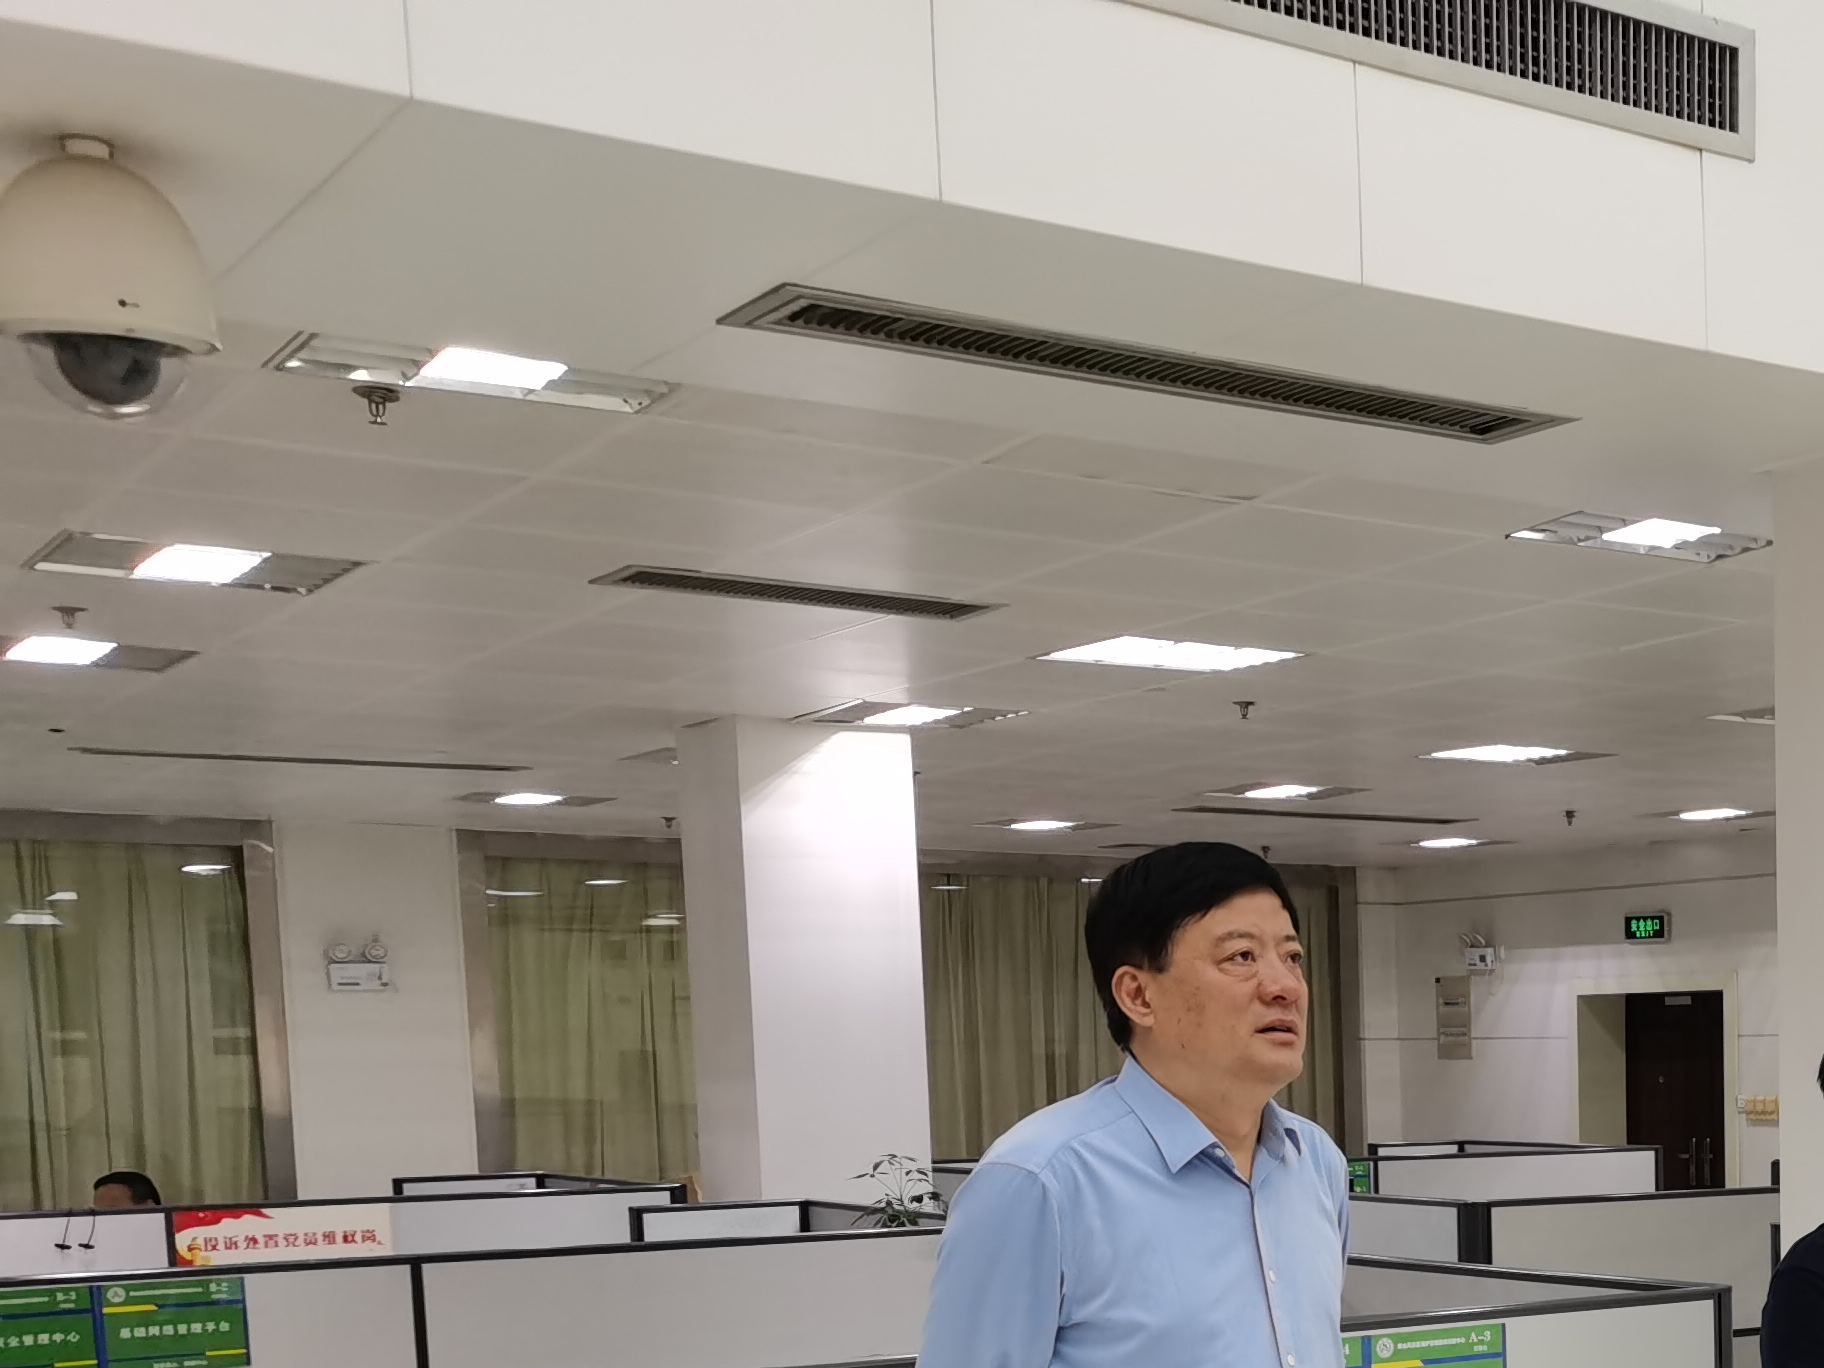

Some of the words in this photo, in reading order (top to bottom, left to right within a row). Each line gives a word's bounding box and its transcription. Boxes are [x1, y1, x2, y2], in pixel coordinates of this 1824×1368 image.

[1631, 918, 1659, 931] 安全出口
[1469, 1331, 1491, 1343] A-3
